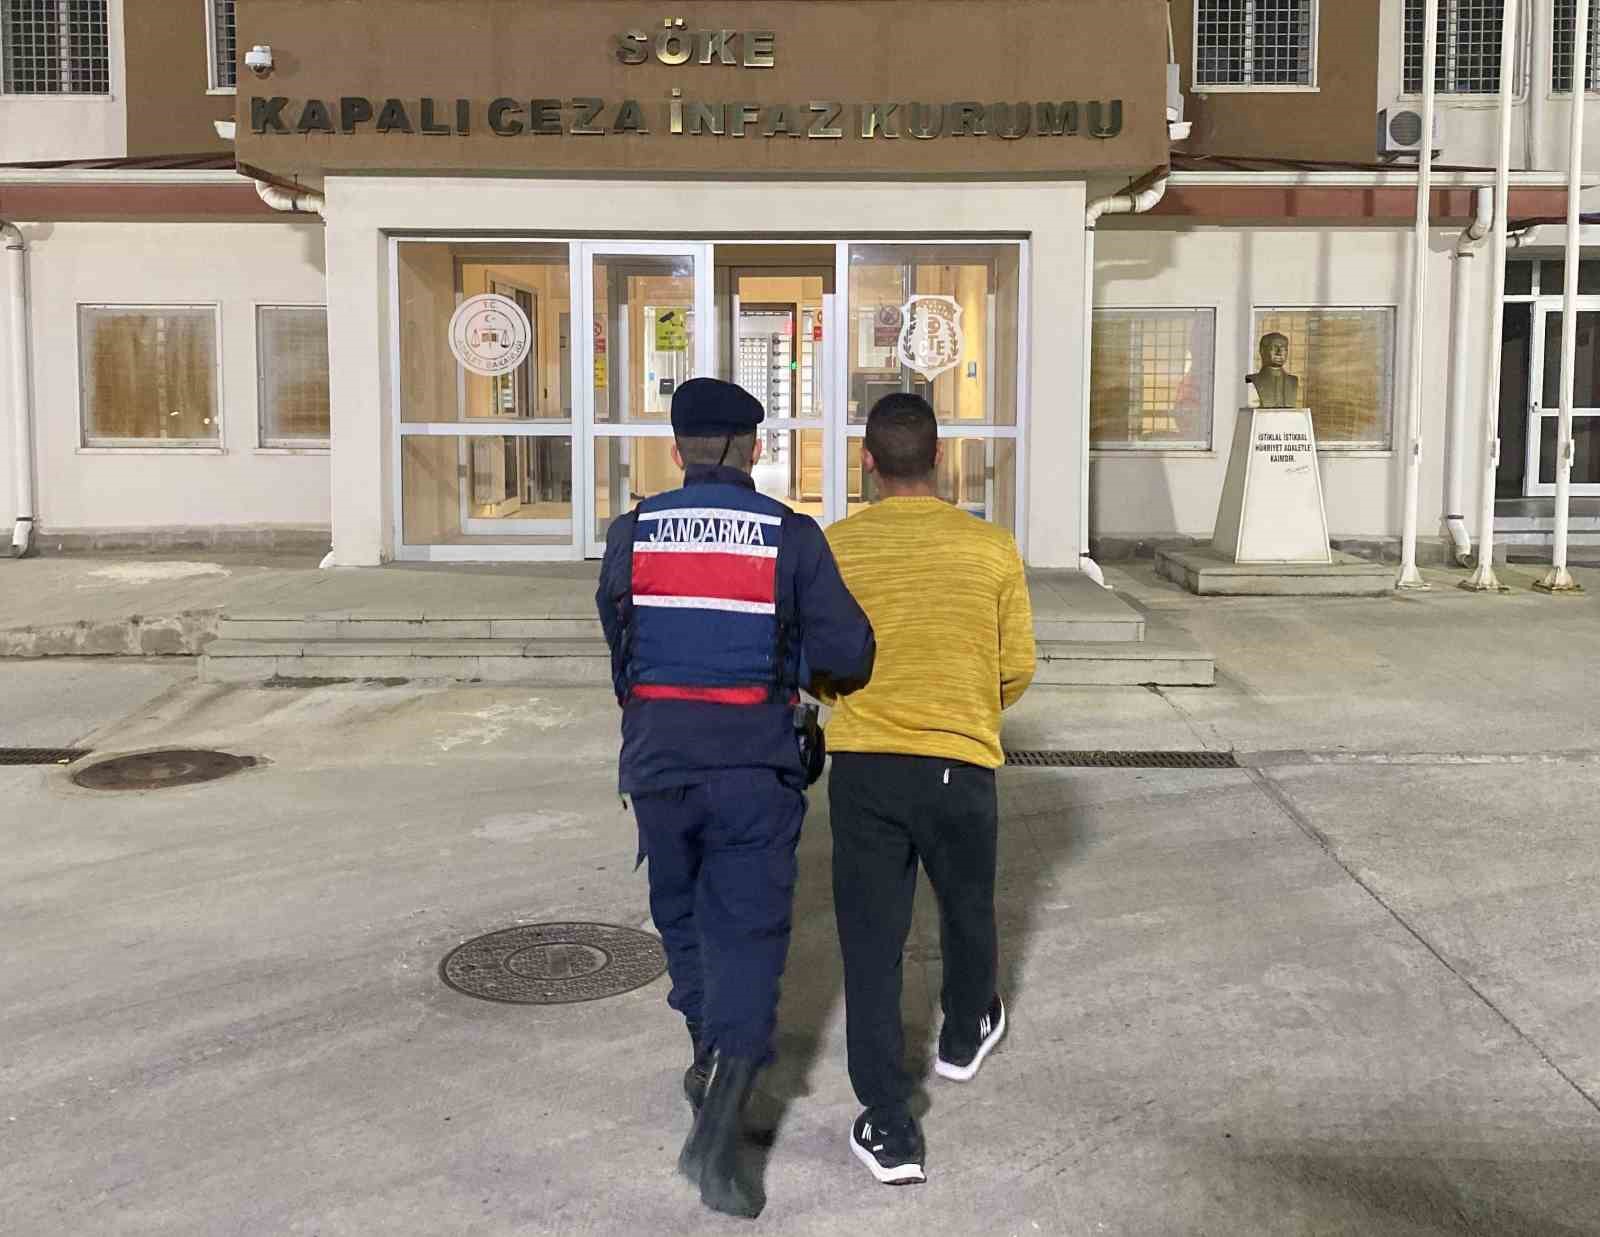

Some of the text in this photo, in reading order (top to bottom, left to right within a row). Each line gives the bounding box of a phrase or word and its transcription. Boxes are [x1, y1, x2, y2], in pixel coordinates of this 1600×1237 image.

[615, 16, 776, 68] SÖKE
[250, 88, 1124, 139] KAPALI CEZA İNFAZ KURUMU
[649, 517, 765, 546] JANDARMA
